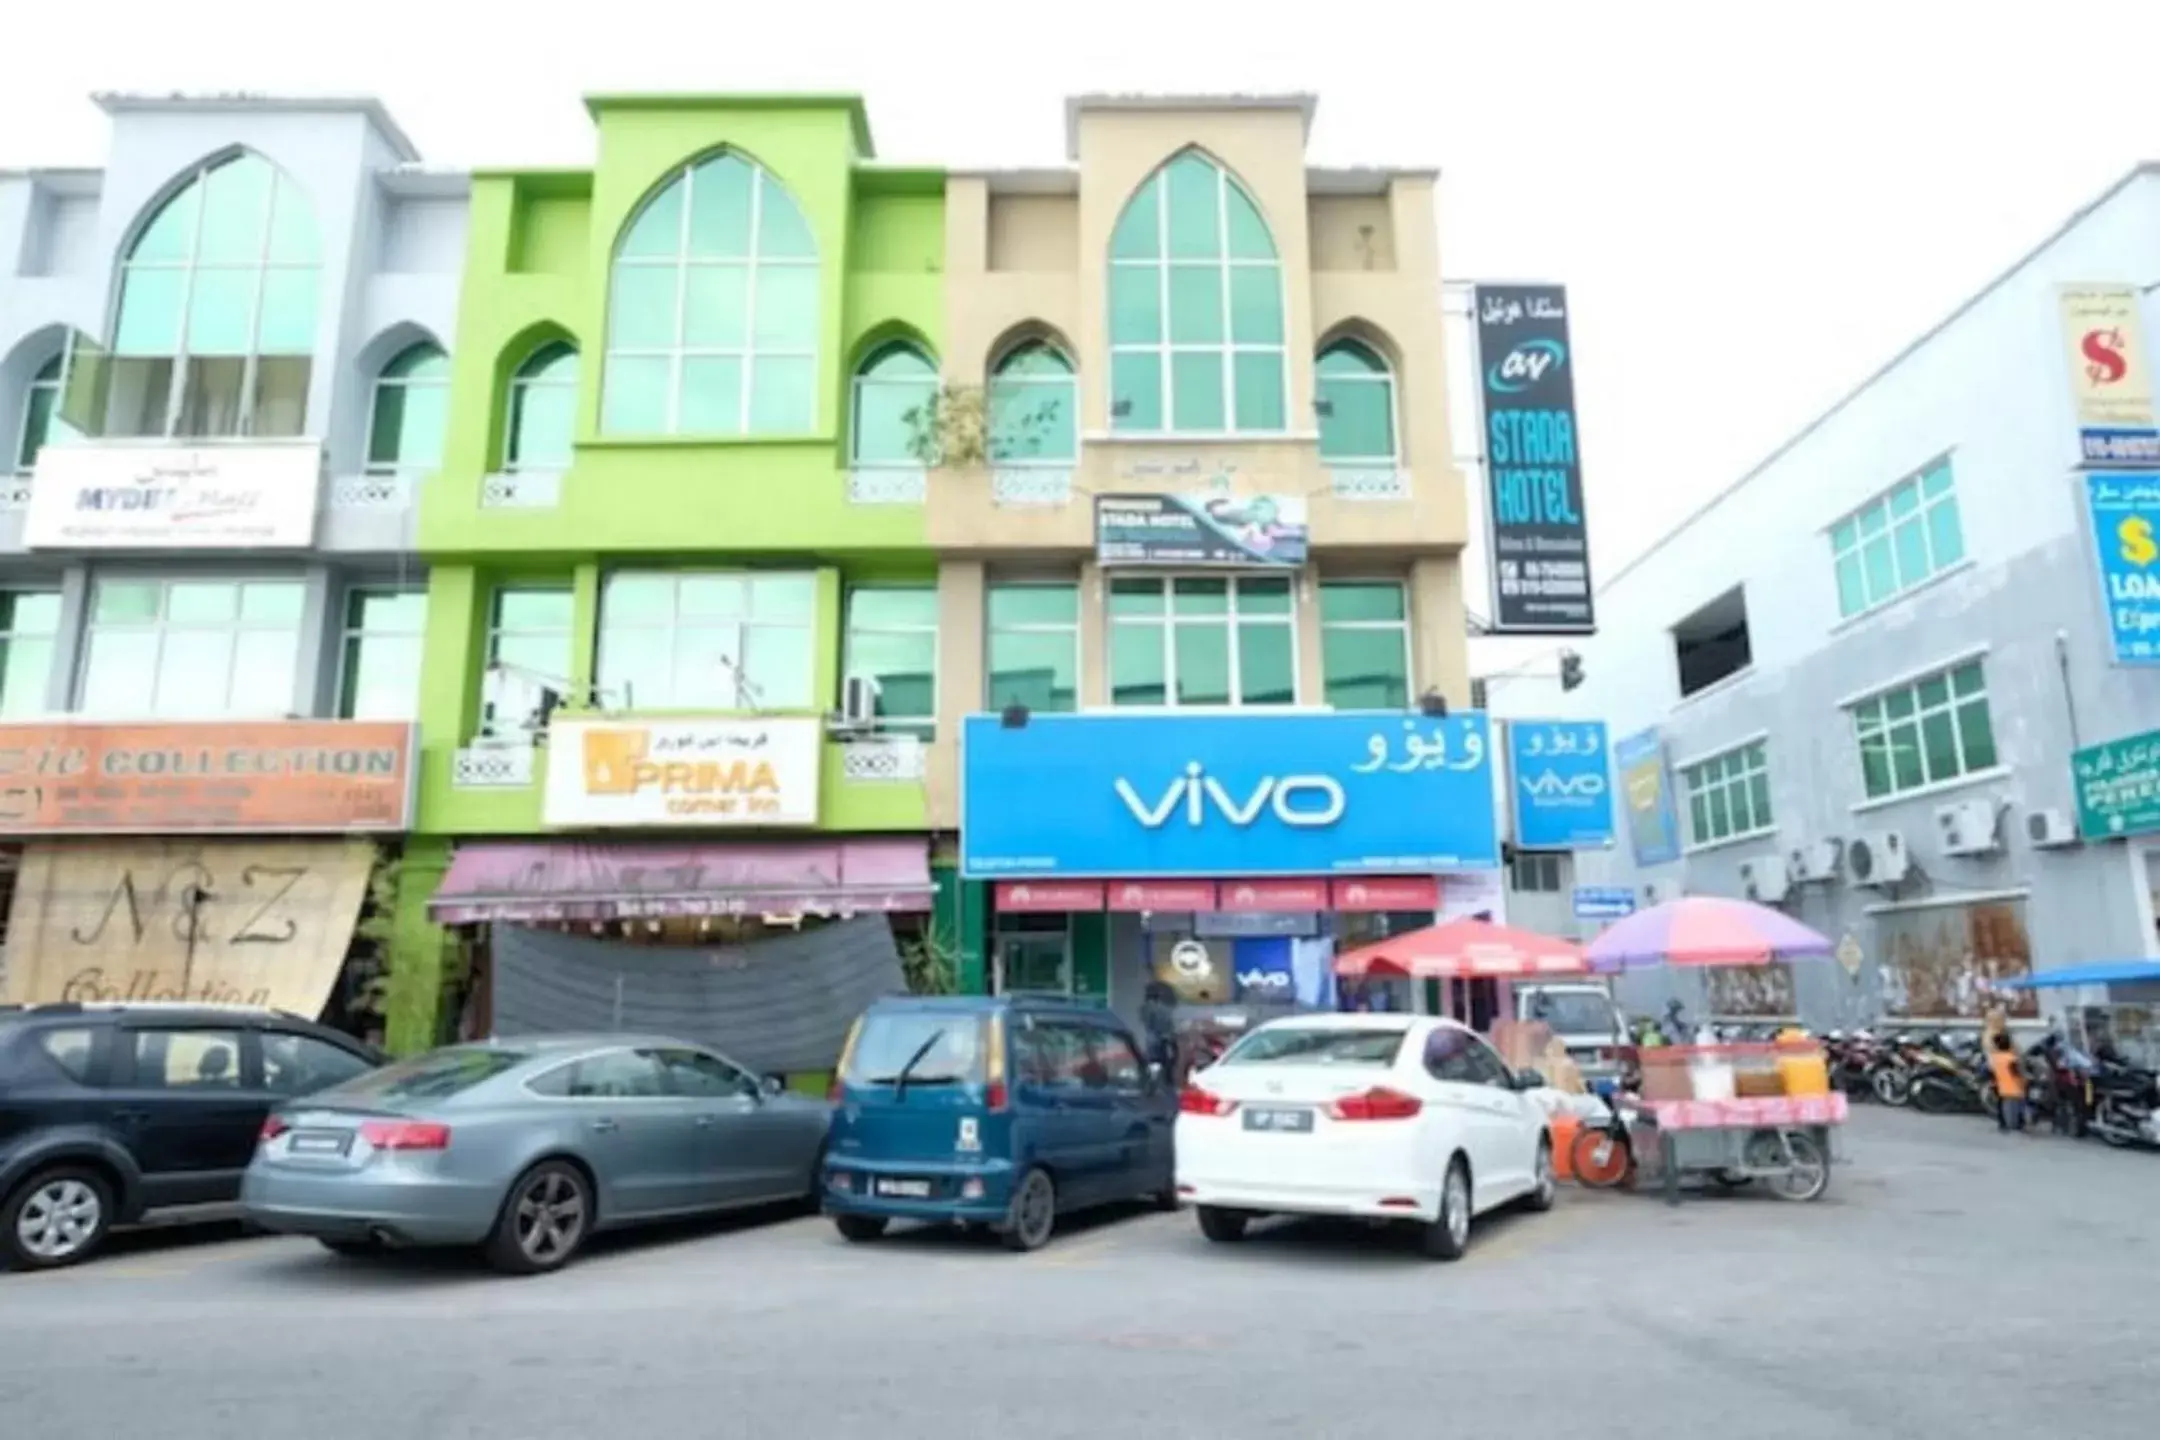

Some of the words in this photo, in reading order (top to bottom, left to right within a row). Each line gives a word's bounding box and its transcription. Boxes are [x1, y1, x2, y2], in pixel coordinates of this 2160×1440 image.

[1496, 469, 1579, 525] HOTEL
[633, 760, 780, 793] PRIMA
[229, 865, 307, 946] Z
